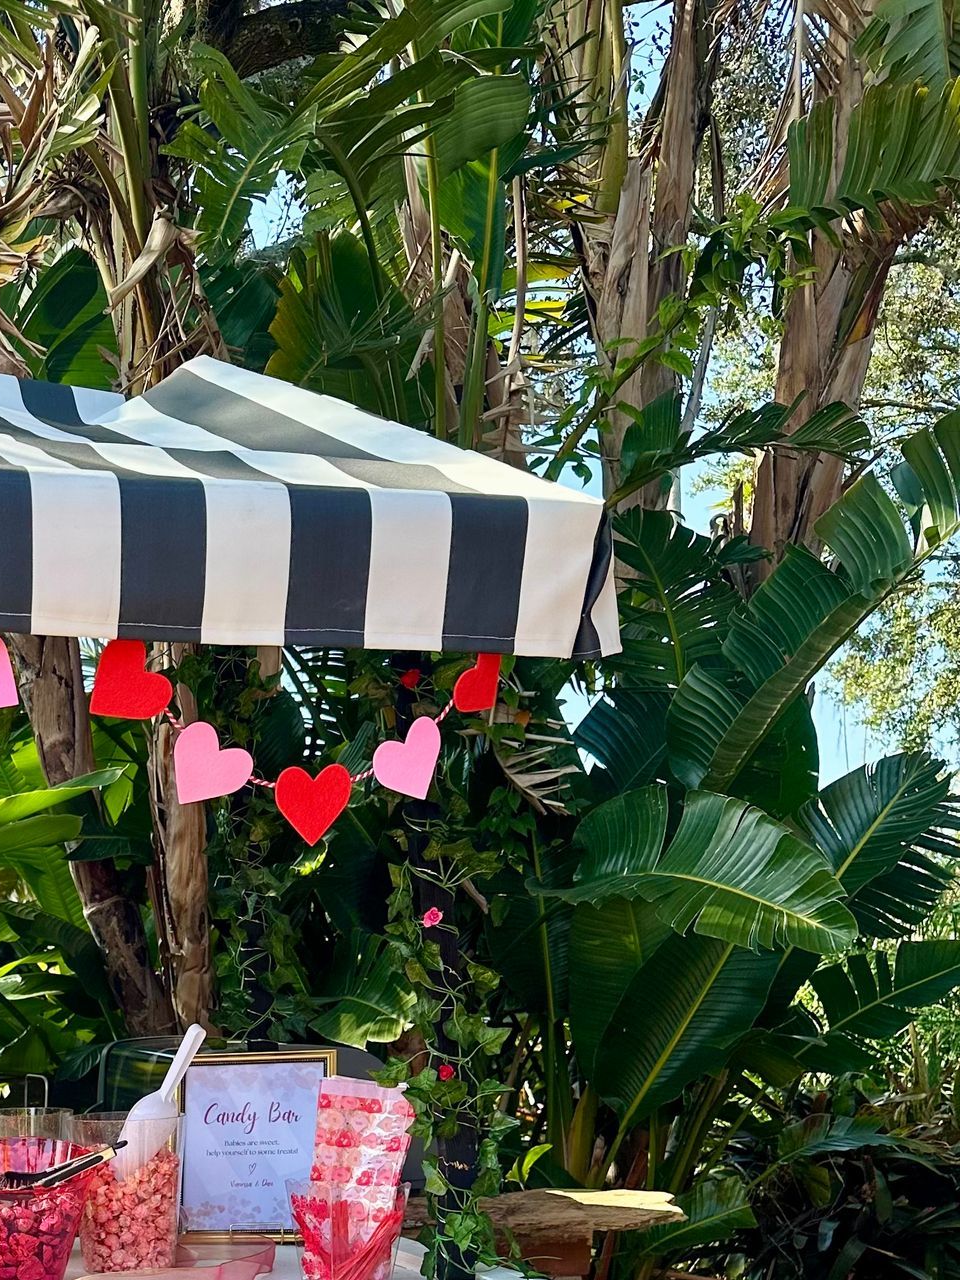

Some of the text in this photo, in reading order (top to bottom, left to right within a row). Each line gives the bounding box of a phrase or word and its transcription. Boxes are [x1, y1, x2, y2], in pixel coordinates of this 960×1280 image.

[204, 1101, 301, 1134] Candy Bar
[224, 1139, 246, 1147] Babies
[206, 1149, 220, 1157] help
[221, 1149, 249, 1157] yourself
